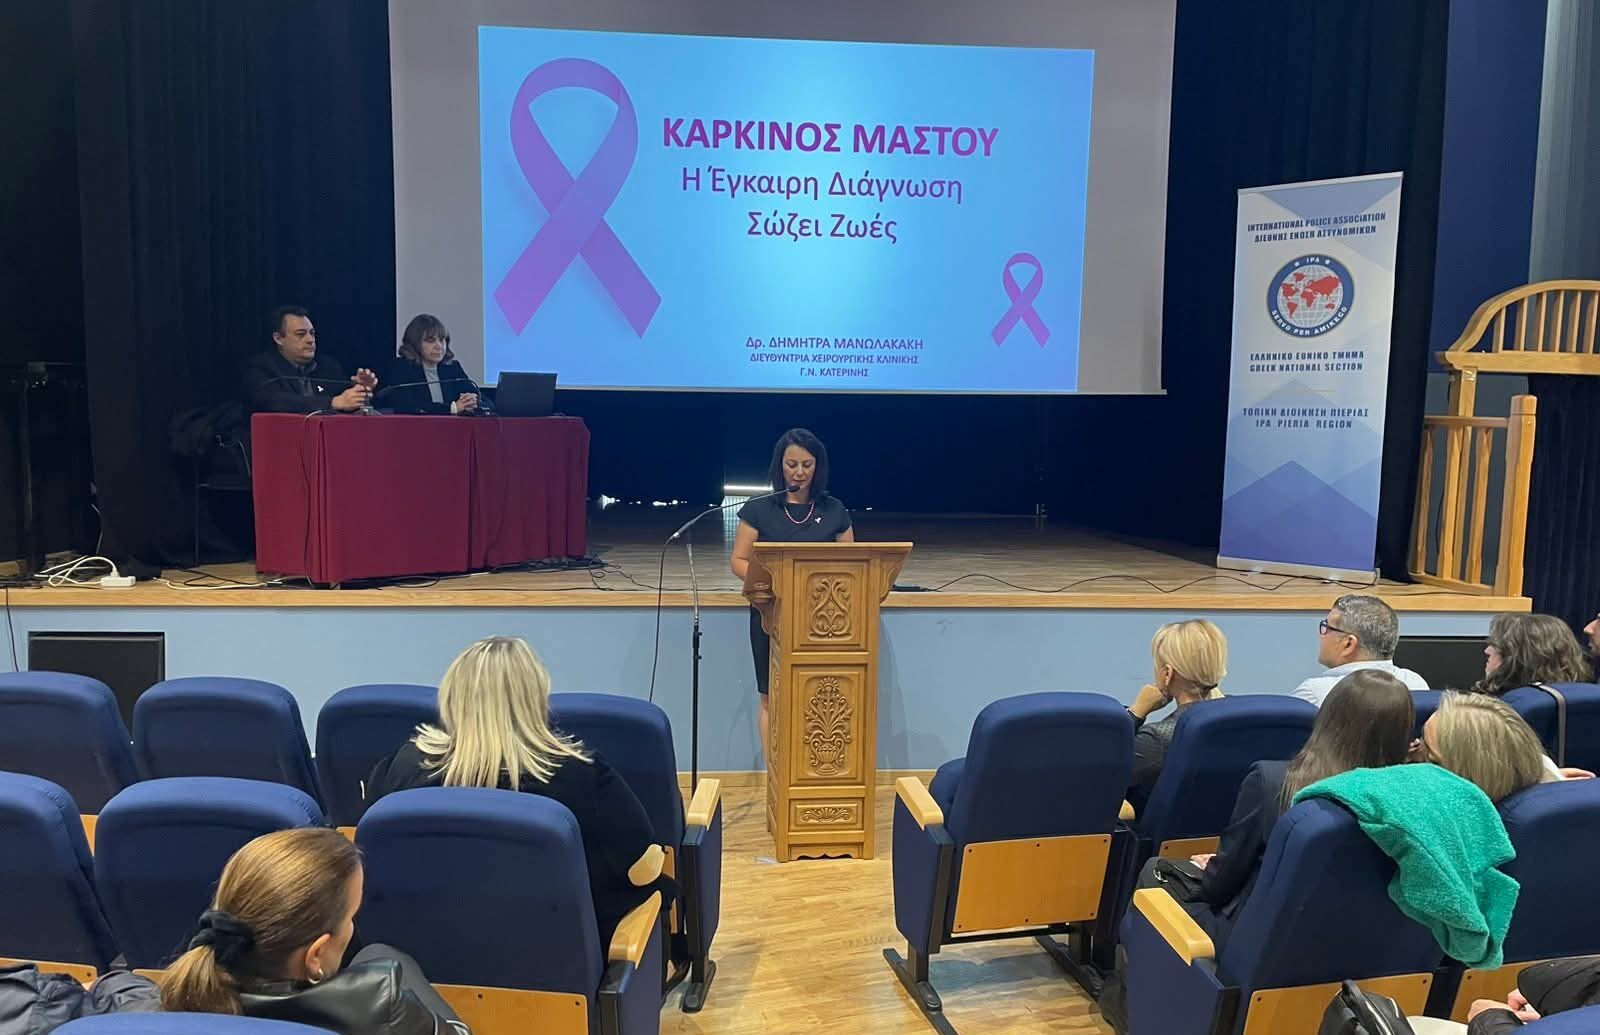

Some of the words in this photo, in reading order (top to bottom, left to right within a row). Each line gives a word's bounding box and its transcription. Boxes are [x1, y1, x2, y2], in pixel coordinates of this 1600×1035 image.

[663, 118, 842, 153] ΚΑΡΚΙΝΟΣ
[853, 124, 999, 157] ΜΑΣΤΟΥ
[682, 167, 701, 191] Η
[707, 165, 819, 200] Έγκαιρη
[828, 170, 963, 204] Διάγνωση
[747, 210, 822, 242] Σώζει
[829, 212, 898, 244] Ζωές
[1247, 220, 1304, 232] INTERNATIONAL
[1305, 216, 1331, 227] POLICE
[1333, 212, 1386, 225] ASSOCIATION
[1254, 232, 1288, 243] ΔΙΕΘΝΗΣ
[1289, 230, 1315, 240] ΕΝΩΣΗ
[1317, 225, 1377, 238] ΑΣΤΥΝΟΜΙΚΩΝ
[1271, 310, 1292, 331] SERVO
[1293, 328, 1311, 336] PER
[1314, 306, 1348, 335] AMIKECO
[746, 337, 766, 350] Δρ.
[769, 337, 831, 349] ΔΗΜΗΤΡΑ
[834, 338, 923, 350] ΜΑΝΩΛΑΚΑΚΗ
[750, 353, 810, 363] ΔΙΕΥΘΥΝΤΡΙΑ
[811, 354, 875, 364] ΧΕΙΡΟΥΡΓΙΚΗΣ
[876, 355, 918, 364] ΚΛΙΝΙΚΗΣ
[1250, 352, 1293, 361] ΕΛΛΗΝΙΚΟ
[1296, 351, 1328, 360] ΕΘΝΙΚΟ
[1332, 350, 1364, 359] ΤΜΗΜΑ
[800, 368, 817, 377] Γ.Ν.
[819, 368, 870, 377] ΚΑΤΕΡΙΝΗΣ
[1250, 364, 1276, 372] GREEK
[1279, 363, 1321, 372] NATIONAL
[1324, 362, 1363, 371] SECTION
[1243, 408, 1277, 416] ΤΟΠΙΚΗ
[1280, 408, 1327, 417] ΔΙΟΙΚΗΣΗ
[1330, 408, 1369, 417] ΠΙΕΡΙΑΣ
[1256, 419, 1271, 428] IPA
[1278, 419, 1309, 428] PIERIA
[1316, 420, 1352, 429] REGION
